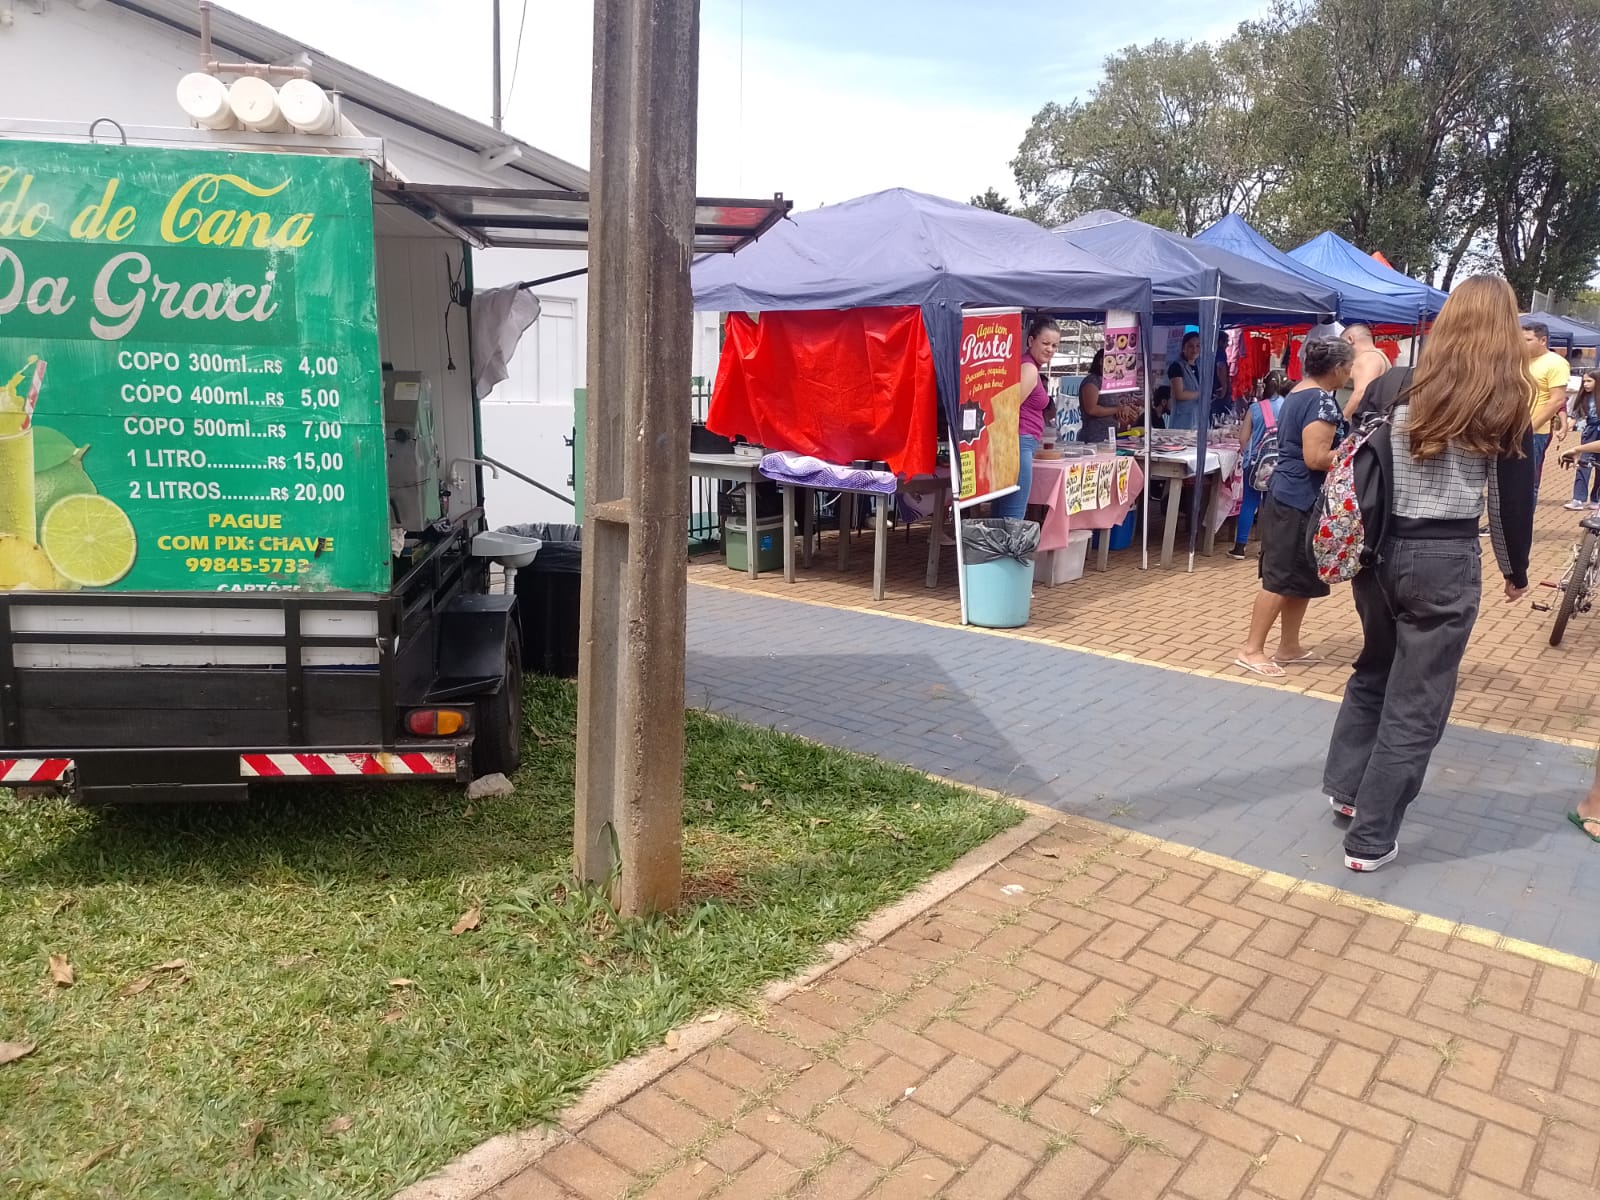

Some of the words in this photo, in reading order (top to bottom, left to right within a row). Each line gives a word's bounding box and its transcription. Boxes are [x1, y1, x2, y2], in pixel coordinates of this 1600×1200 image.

[70, 178, 137, 242] de
[160, 173, 315, 248] Cana
[89, 251, 279, 341] Graci
[976, 323, 994, 339] Aqui
[995, 323, 1008, 335] tem
[960, 333, 1013, 365] Pastel
[118, 351, 180, 371] COPO
[298, 356, 338, 378] 4,00
[120, 384, 183, 404] COPO
[301, 388, 340, 409] 5,00
[123, 416, 185, 436] COPO
[302, 420, 342, 441] 7,00
[127, 449, 136, 467] 1
[293, 452, 343, 473] 15,00
[129, 481, 141, 499] 2
[294, 484, 345, 505] 20,00
[208, 513, 282, 529] PAGUE
[157, 535, 209, 551] COM
[214, 536, 254, 551] PIX:
[259, 536, 334, 552] CHAVE
[185, 557, 310, 573] 99845-5733
